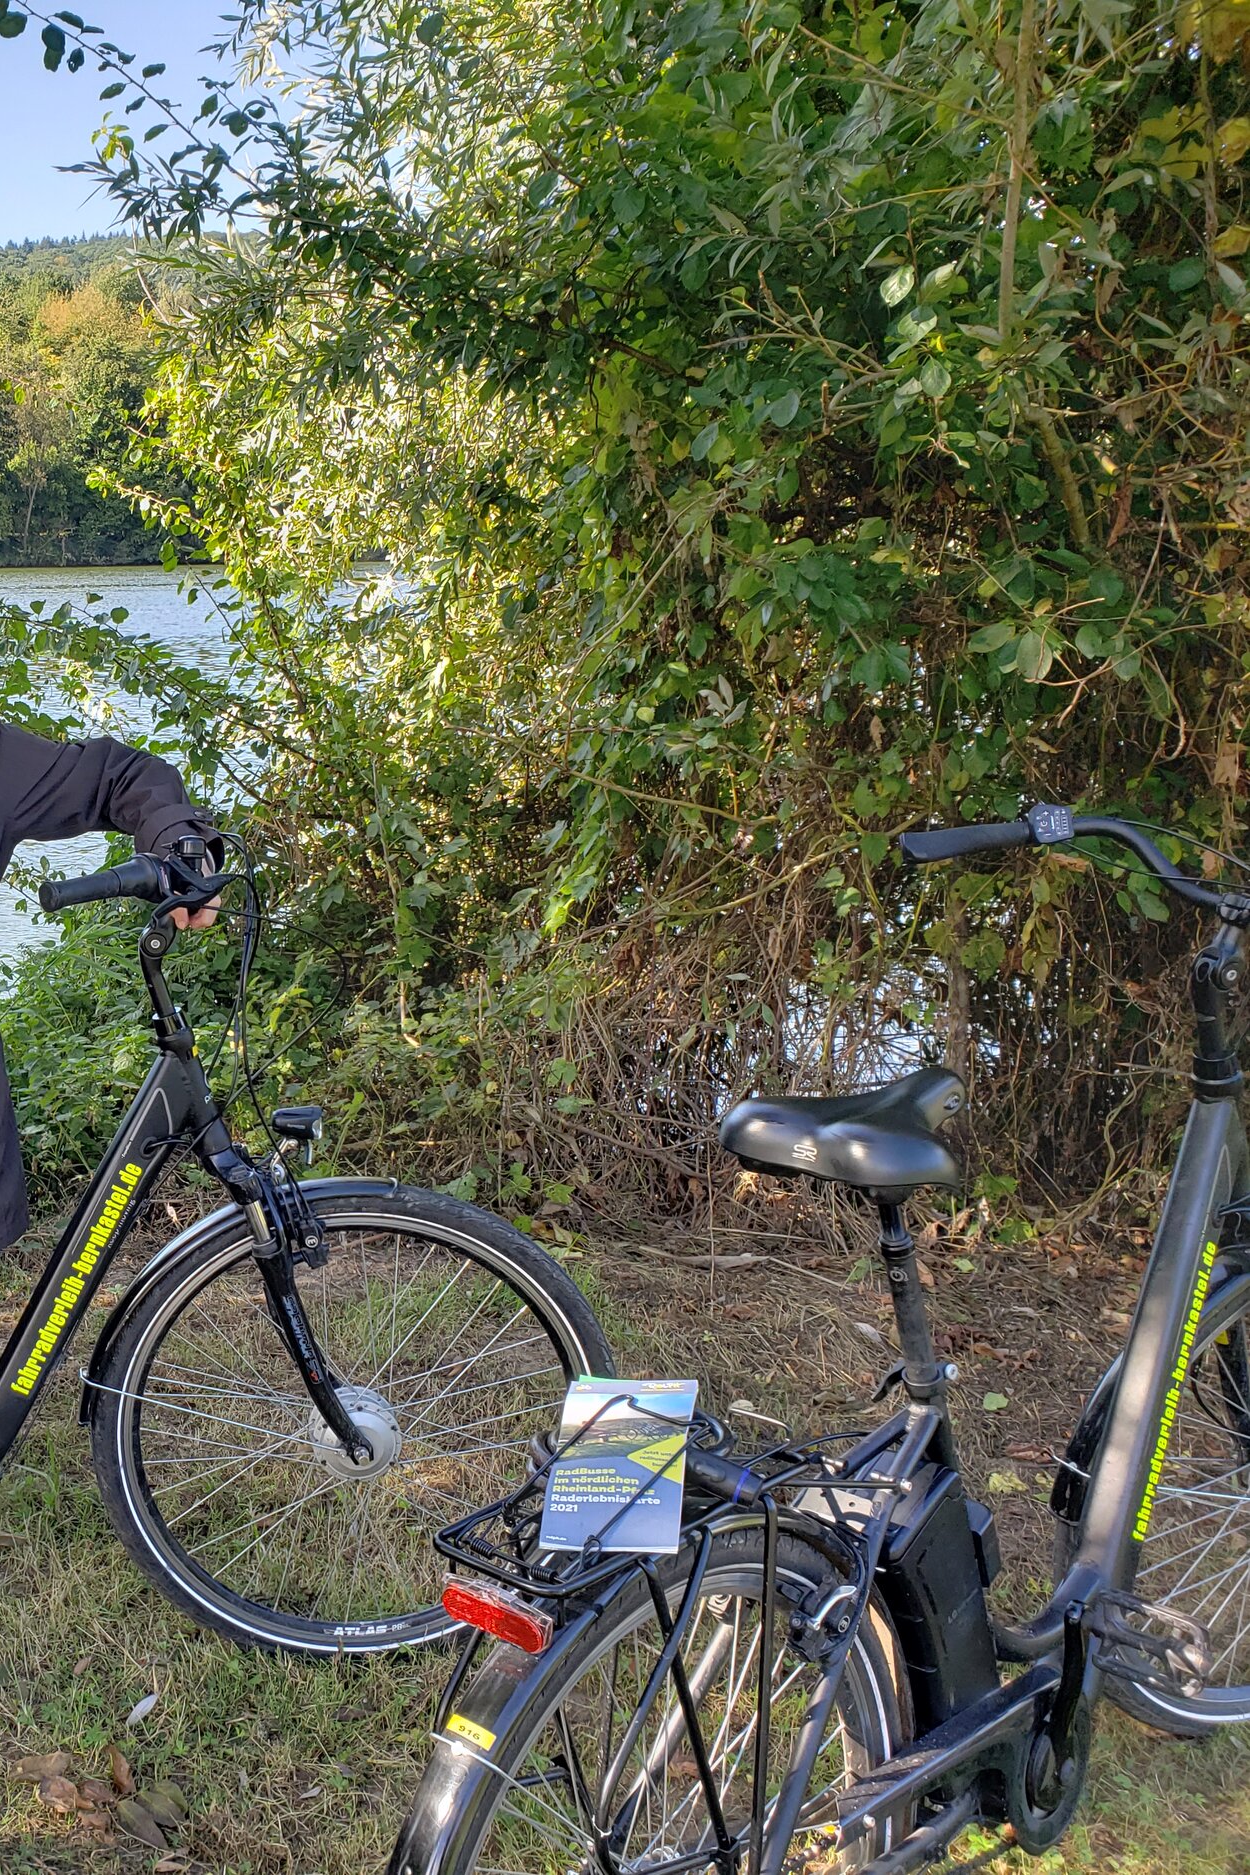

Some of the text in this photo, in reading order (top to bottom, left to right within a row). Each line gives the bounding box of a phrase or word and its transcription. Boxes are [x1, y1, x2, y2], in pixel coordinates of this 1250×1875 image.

[10, 1163, 143, 1396] fahrradverleih-bernkastel.de
[1131, 1241, 1218, 1542] fahrradverleih-bernkastel.de
[554, 1475, 639, 1485] im nördlichen
[549, 1503, 578, 1513] 2021
[333, 1624, 388, 1636] ATLAS
[458, 1725, 480, 1740] 916
